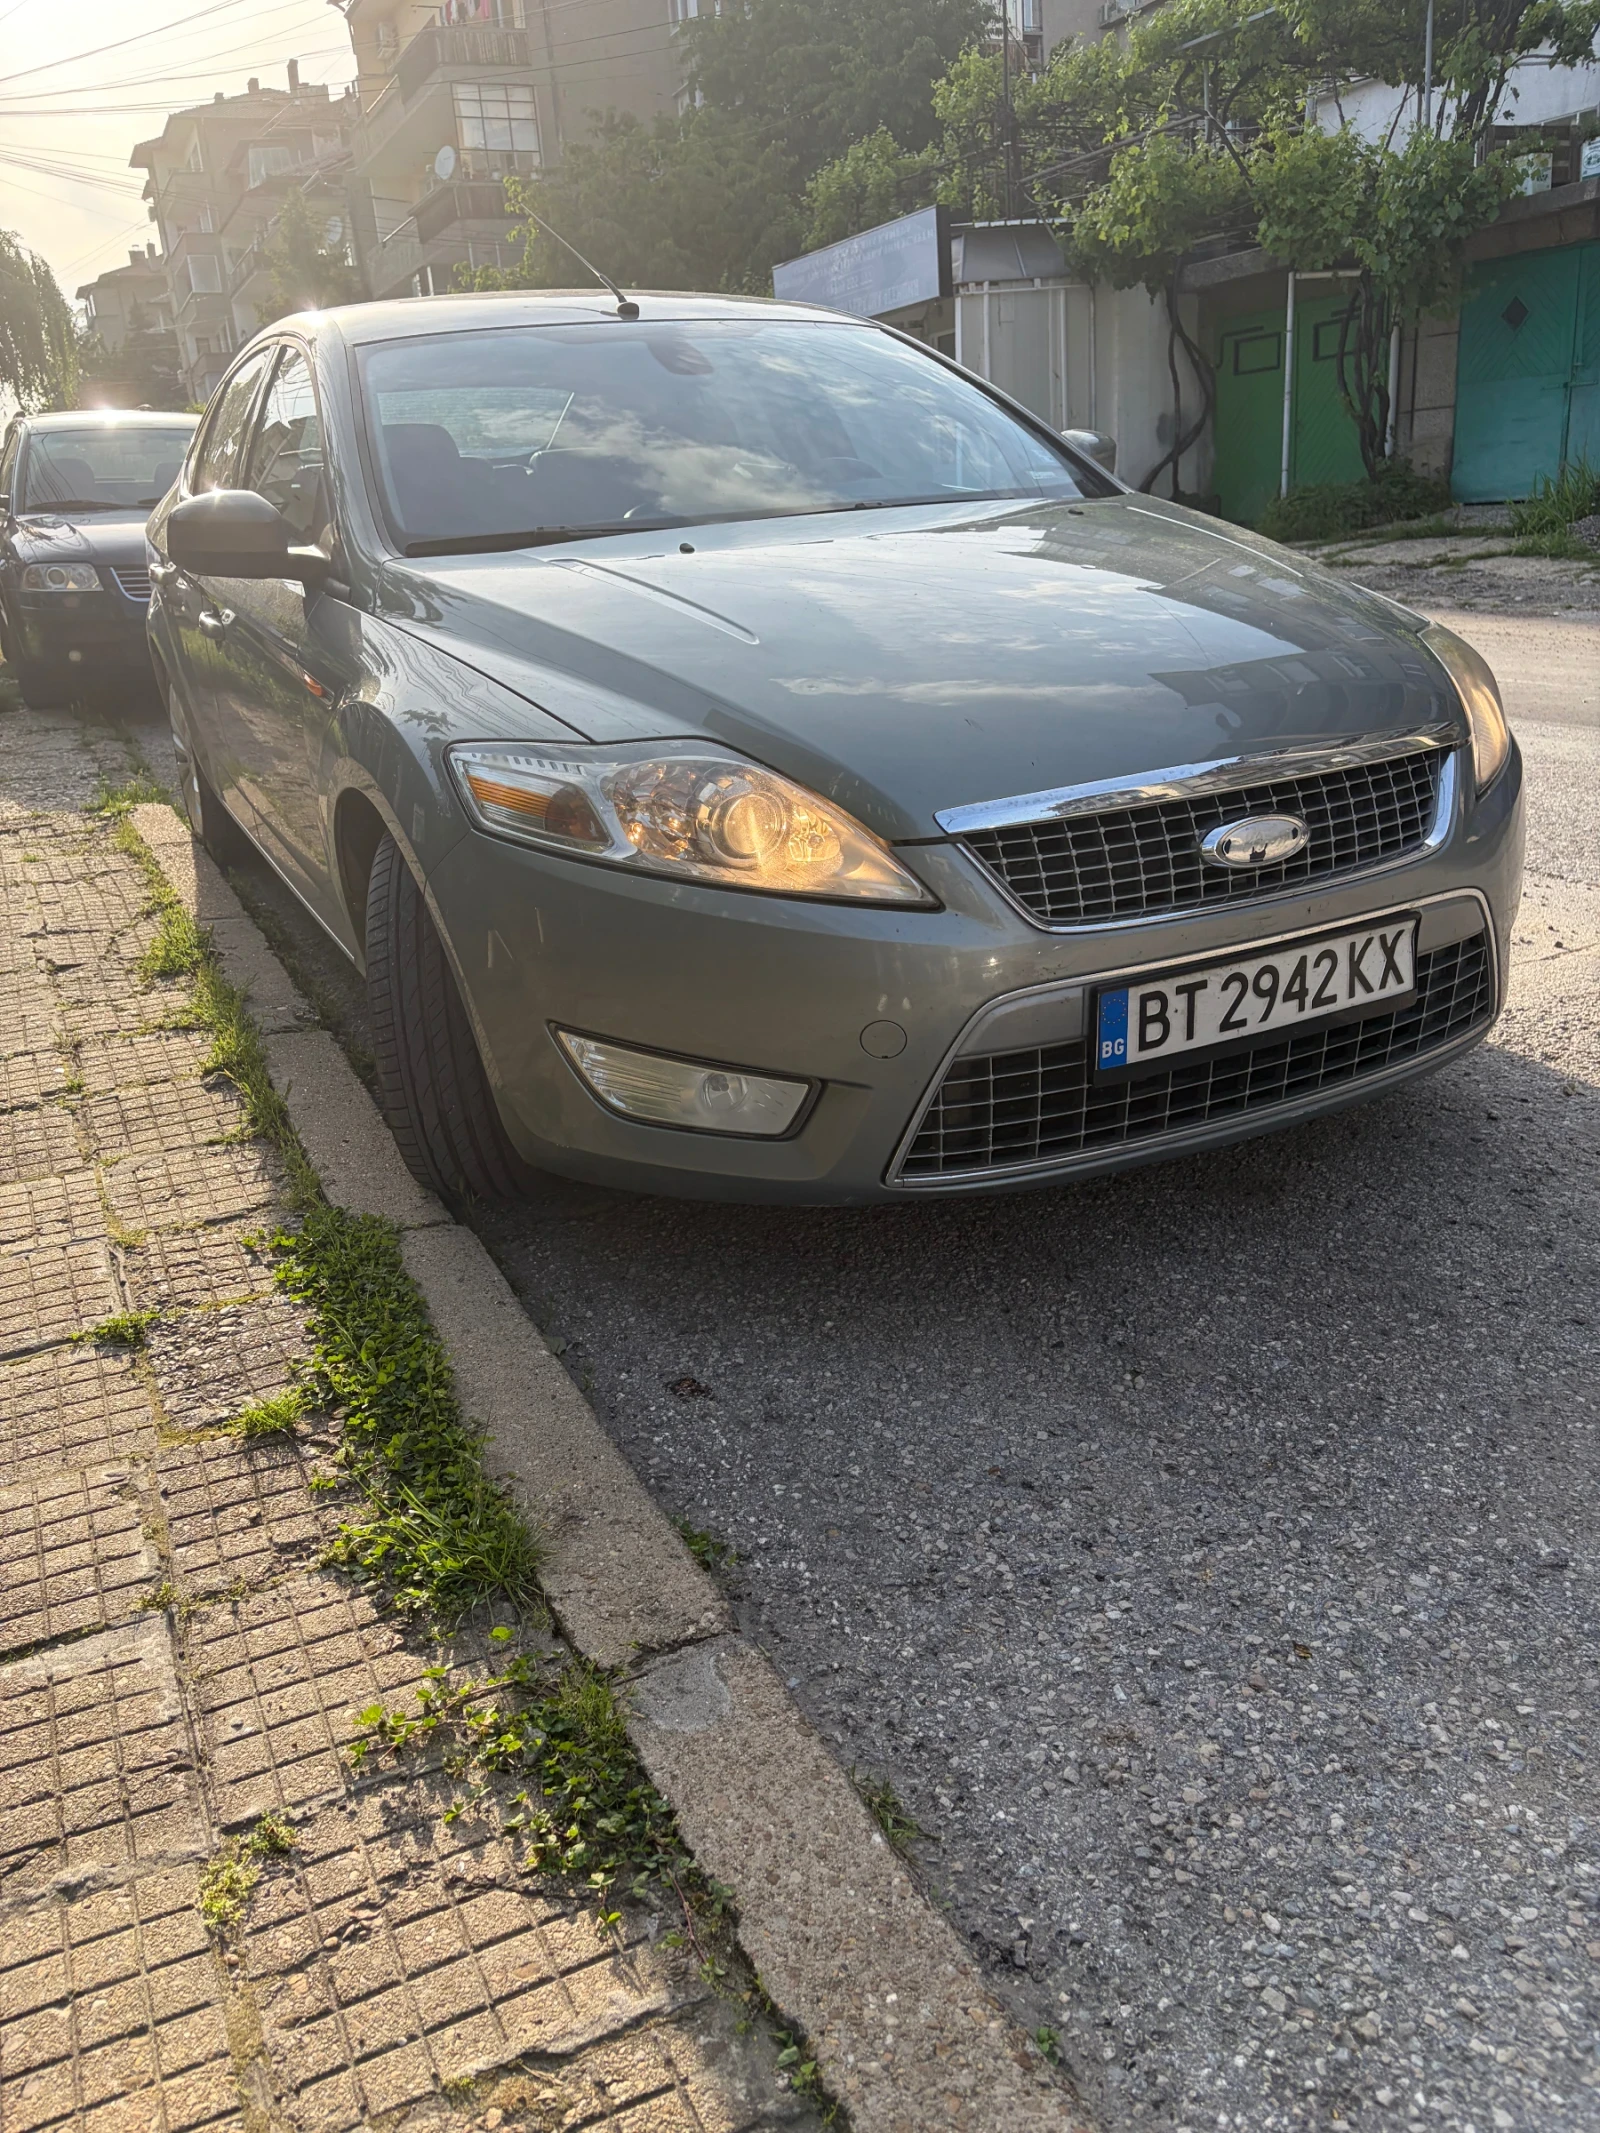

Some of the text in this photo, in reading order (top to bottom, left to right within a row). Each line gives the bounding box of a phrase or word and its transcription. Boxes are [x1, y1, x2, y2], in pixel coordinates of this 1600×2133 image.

[1138, 929, 1406, 1052] BT 2942 KX
[1101, 1038, 1125, 1059] BG
